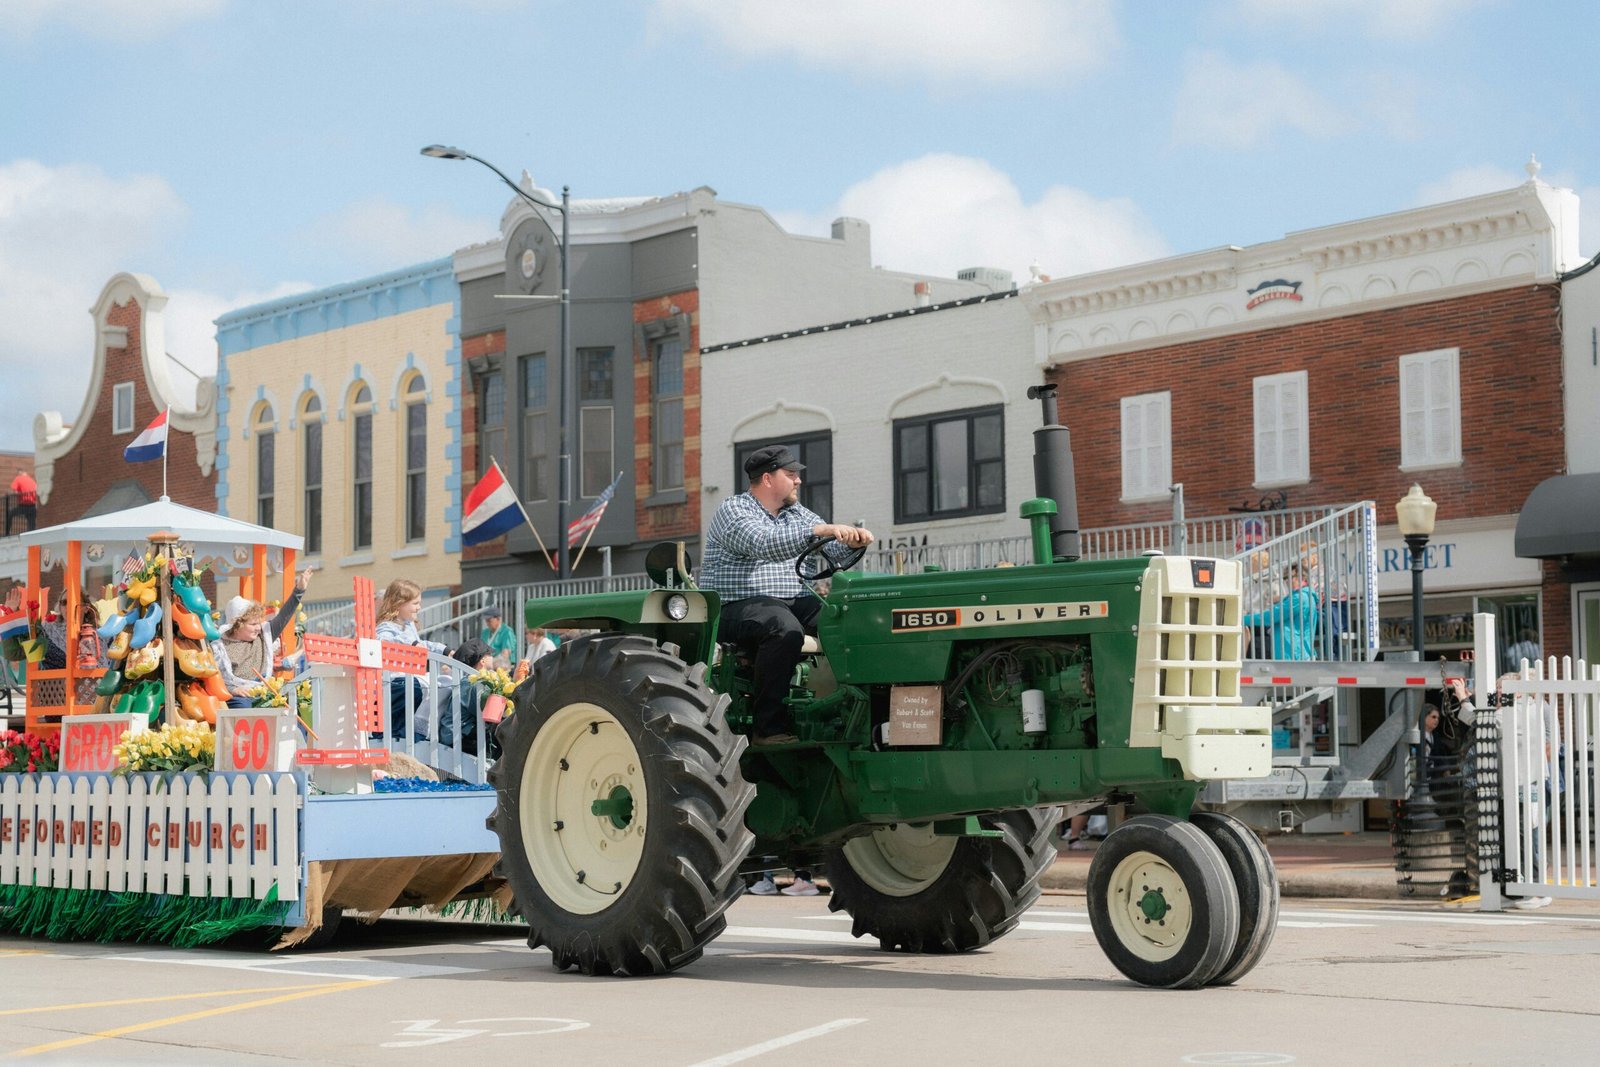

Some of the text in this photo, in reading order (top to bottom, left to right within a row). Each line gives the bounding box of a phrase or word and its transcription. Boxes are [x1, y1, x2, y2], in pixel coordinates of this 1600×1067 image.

[1340, 543, 1457, 577] MRKET
[901, 604, 1091, 627] 1650 OLIVER
[232, 718, 270, 770] GO
[1, 818, 268, 851] EFORMED CHURCH
